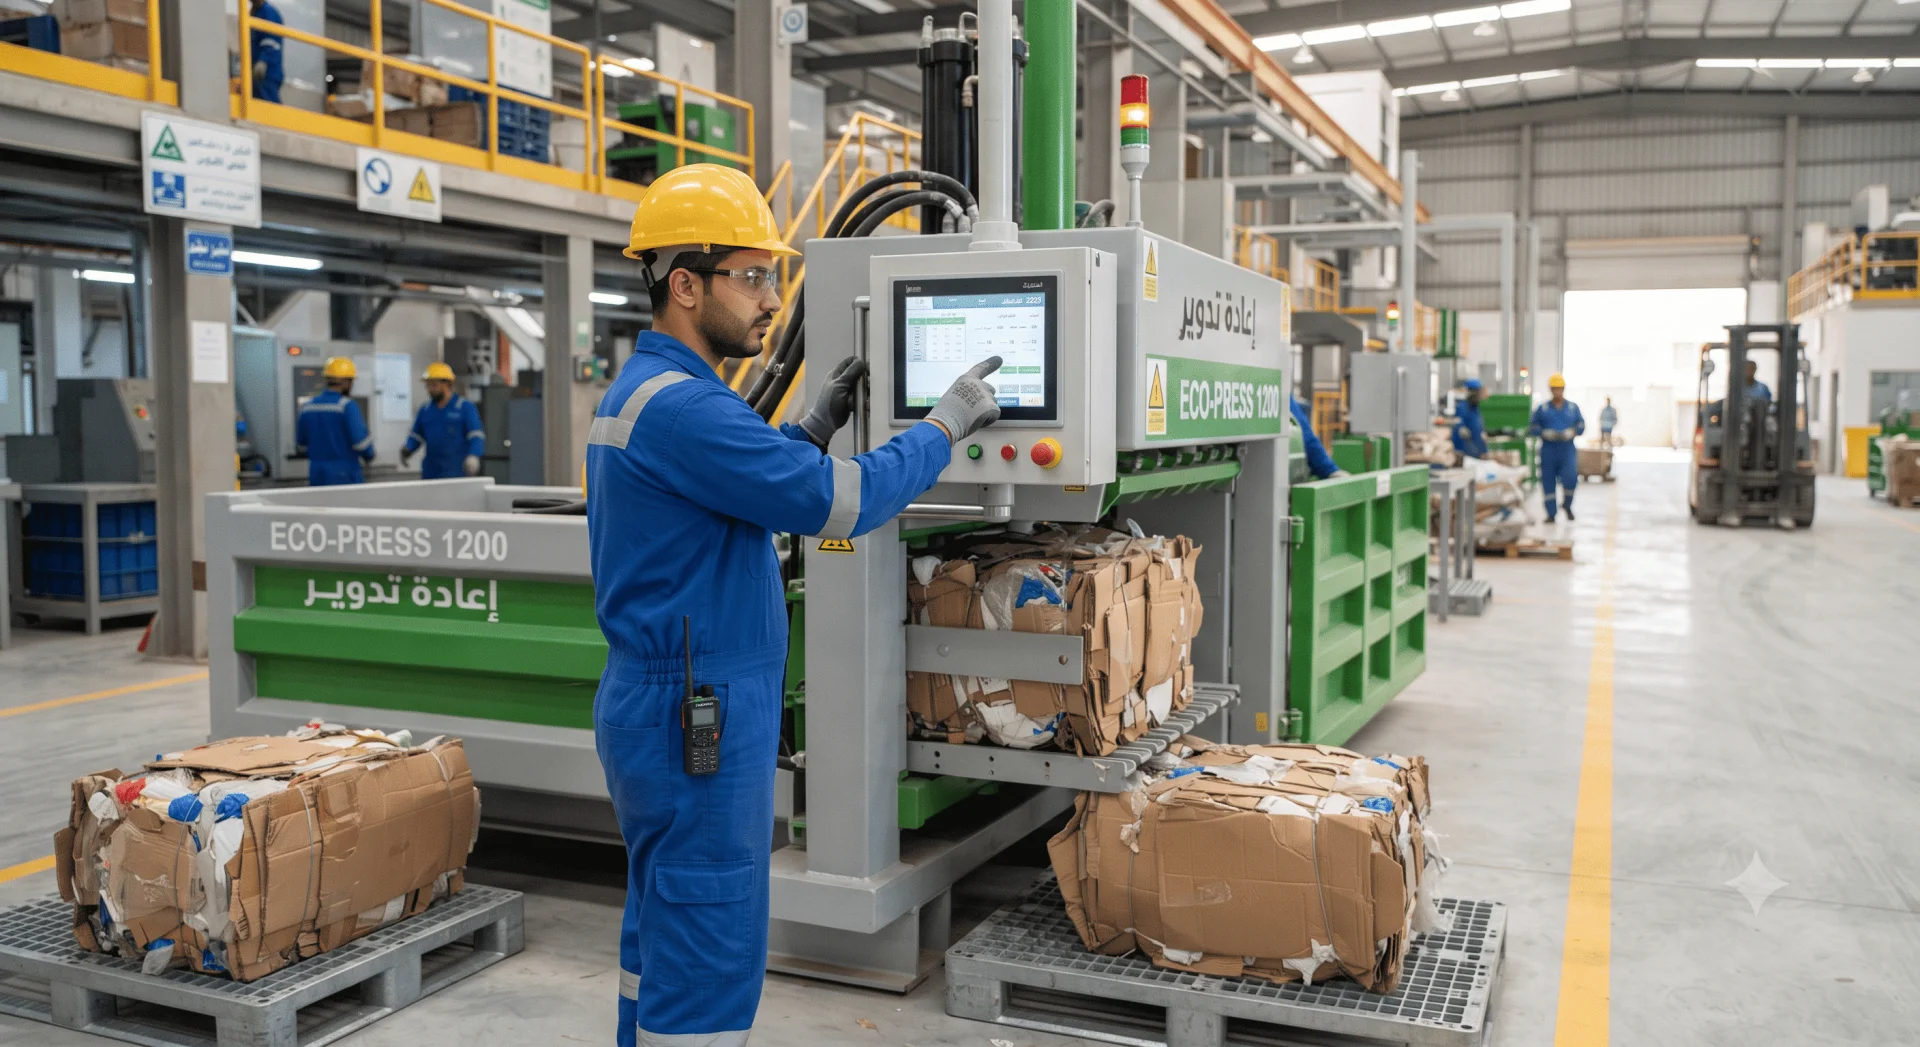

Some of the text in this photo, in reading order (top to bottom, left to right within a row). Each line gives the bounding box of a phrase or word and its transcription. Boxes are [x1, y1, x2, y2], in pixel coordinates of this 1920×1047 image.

[1178, 290, 1256, 350] إعادة تدوير
[1180, 379, 1279, 420] ECO-PRESS 1200
[270, 521, 508, 561] ECO-PRESS 1200
[304, 574, 499, 622] إعادة تدوير
